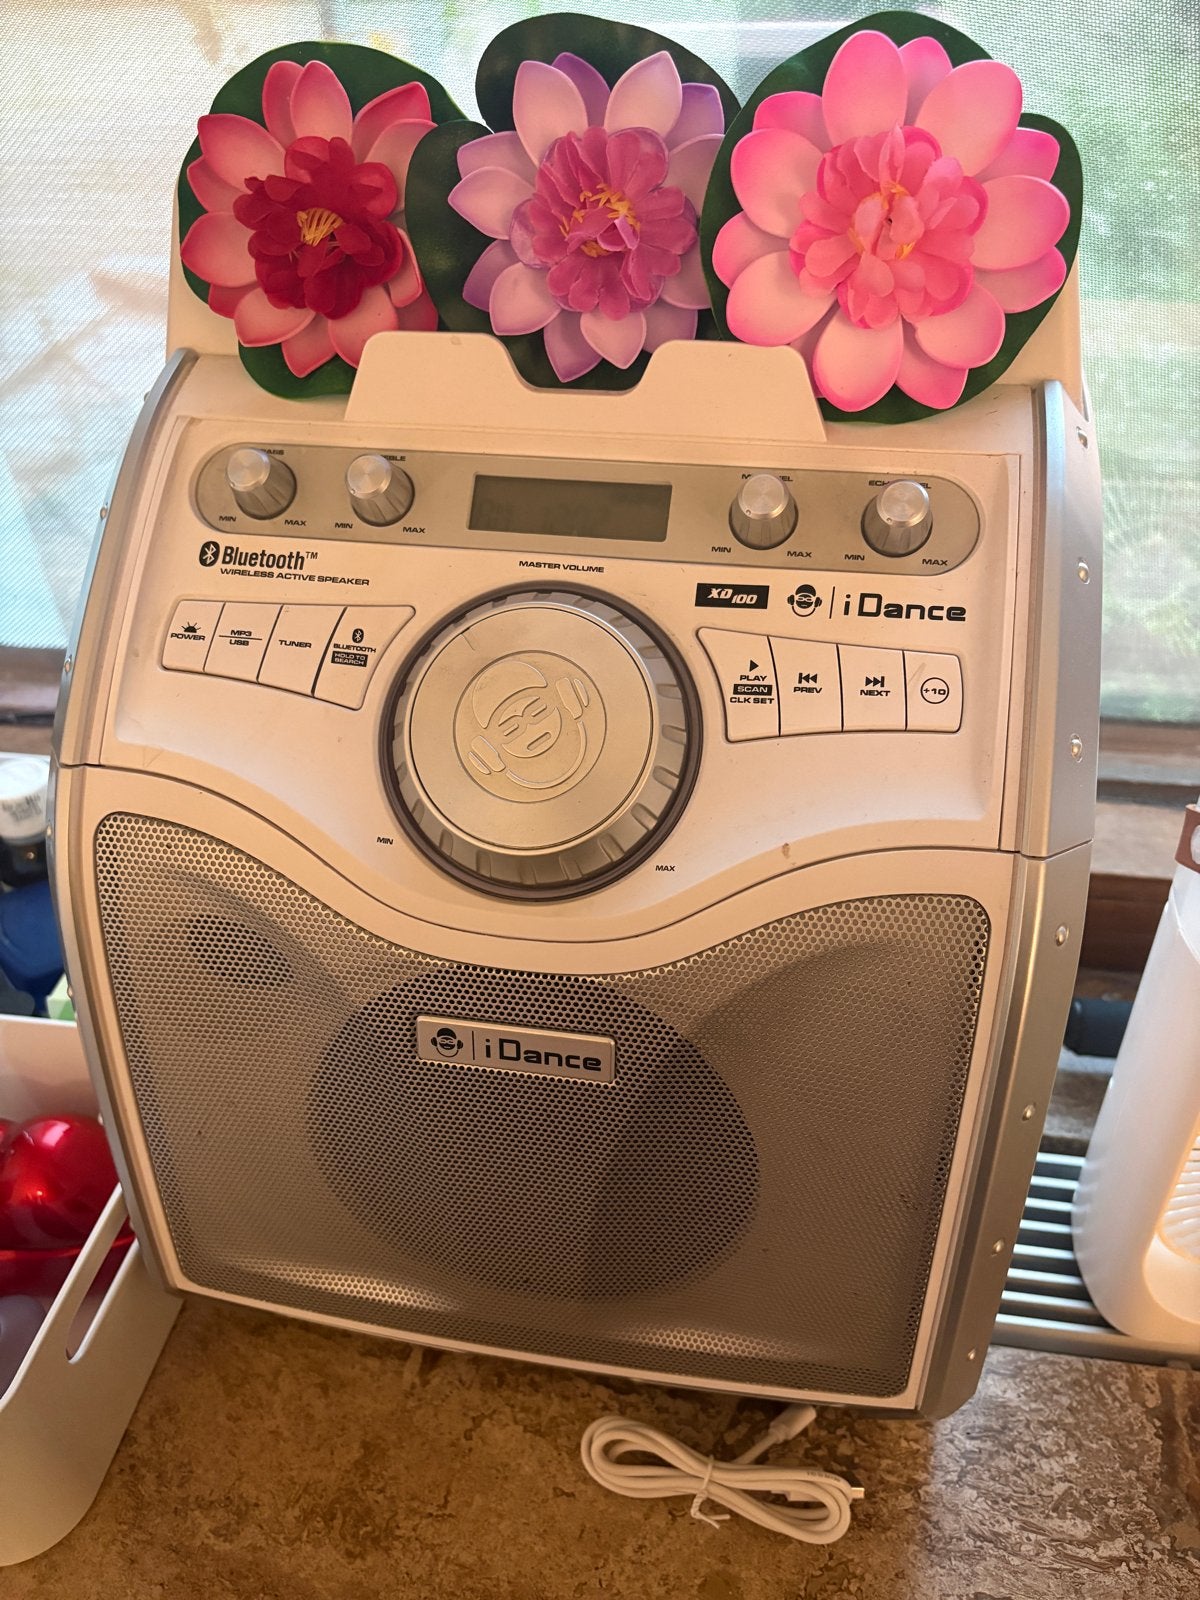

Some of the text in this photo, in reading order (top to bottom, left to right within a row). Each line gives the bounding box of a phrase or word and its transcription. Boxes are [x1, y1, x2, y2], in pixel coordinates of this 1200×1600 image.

[218, 515, 237, 523] MIN
[284, 519, 307, 527] MAX
[334, 522, 354, 530] MIN
[402, 526, 426, 535] MAX
[711, 546, 732, 554] MIN
[786, 550, 812, 559] MAX
[518, 560, 605, 573] MASTER VOLUME
[922, 558, 948, 567] MAX
[220, 568, 370, 586] WIRELESS ACTIVE SPEAKER
[707, 588, 758, 604] XD100
[170, 632, 206, 642] POWER
[230, 629, 252, 638] MP3
[229, 639, 250, 647] USB
[278, 639, 312, 649] TUNER
[333, 643, 377, 654] BLUETOOTH
[334, 657, 365, 666] SEARCH
[739, 674, 768, 682] PLAY
[737, 685, 768, 693] SCAN
[793, 686, 822, 694] PREV
[859, 689, 891, 697] NEXT
[922, 687, 947, 696] +10
[730, 696, 775, 705] CLK SET
[376, 836, 394, 845] MIN
[655, 864, 676, 873] MAX
